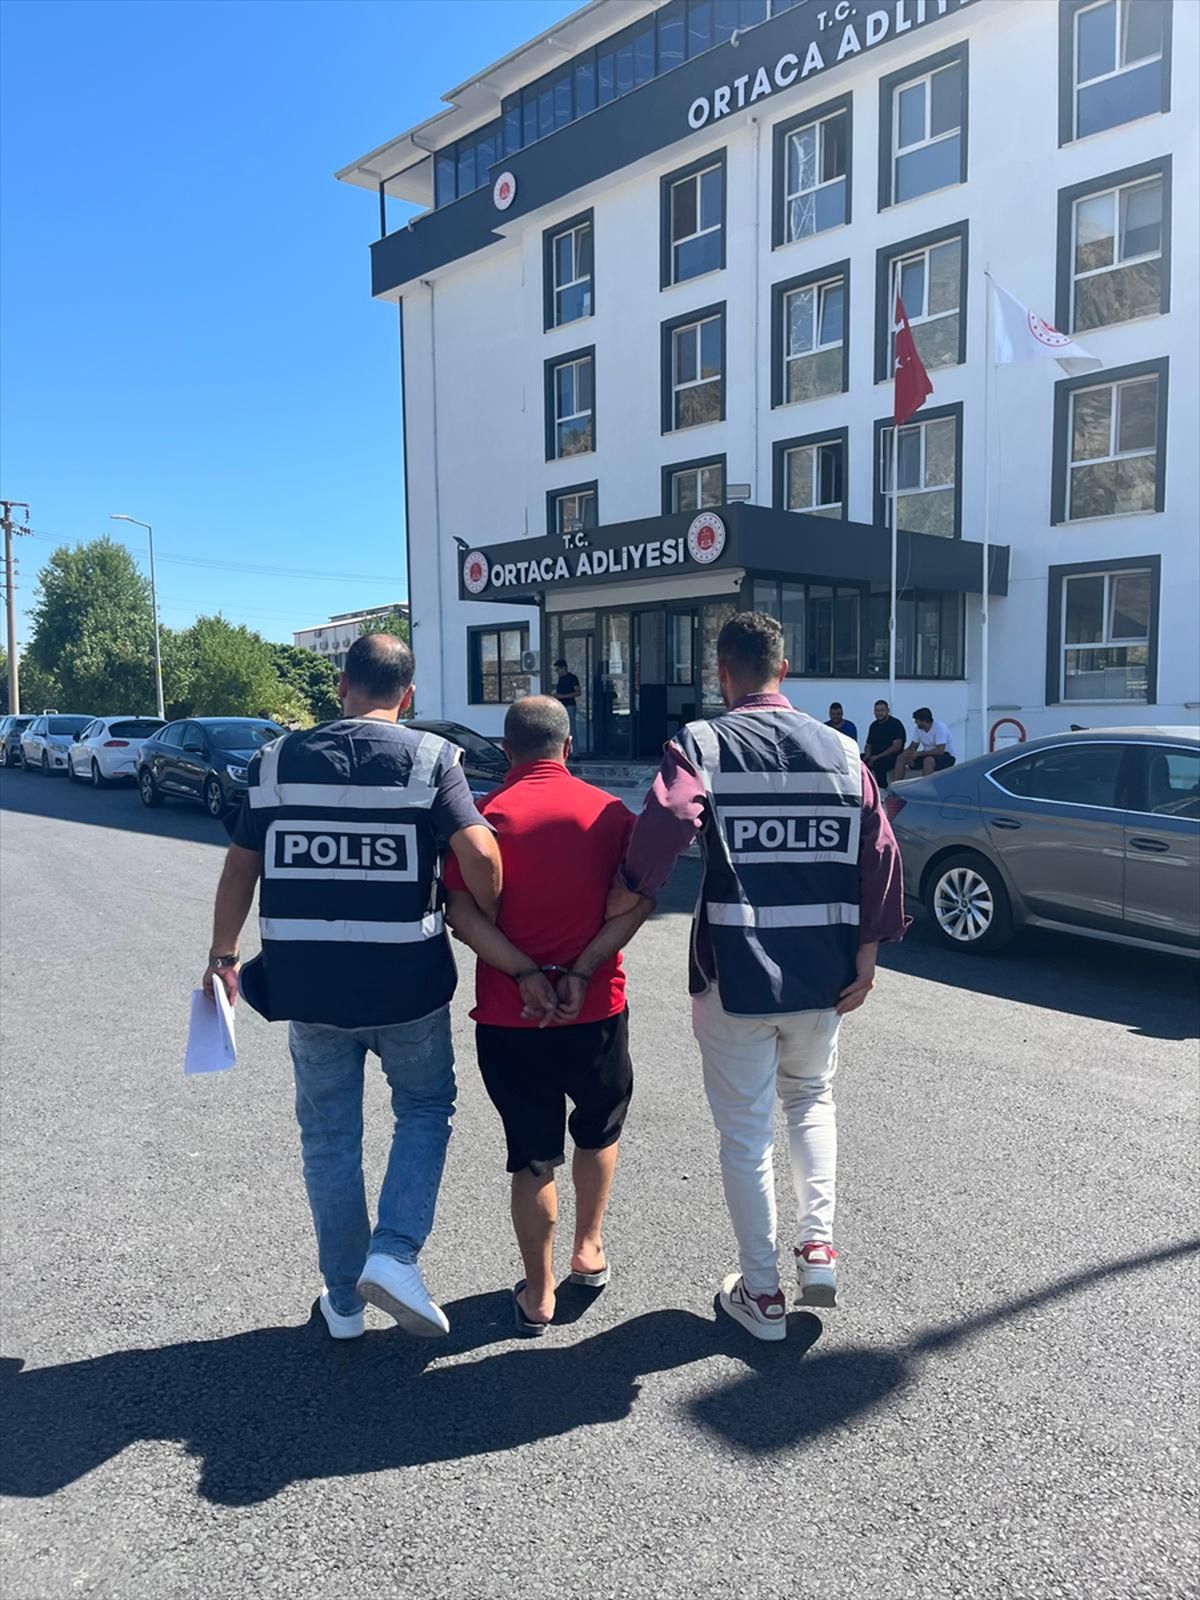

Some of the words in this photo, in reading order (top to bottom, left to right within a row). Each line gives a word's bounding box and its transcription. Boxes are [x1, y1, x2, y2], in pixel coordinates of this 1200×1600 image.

[817, 1, 857, 31] T.C.
[687, 41, 825, 129] ORTACA
[562, 532, 588, 549] T.C.
[491, 556, 570, 587] ORTACA
